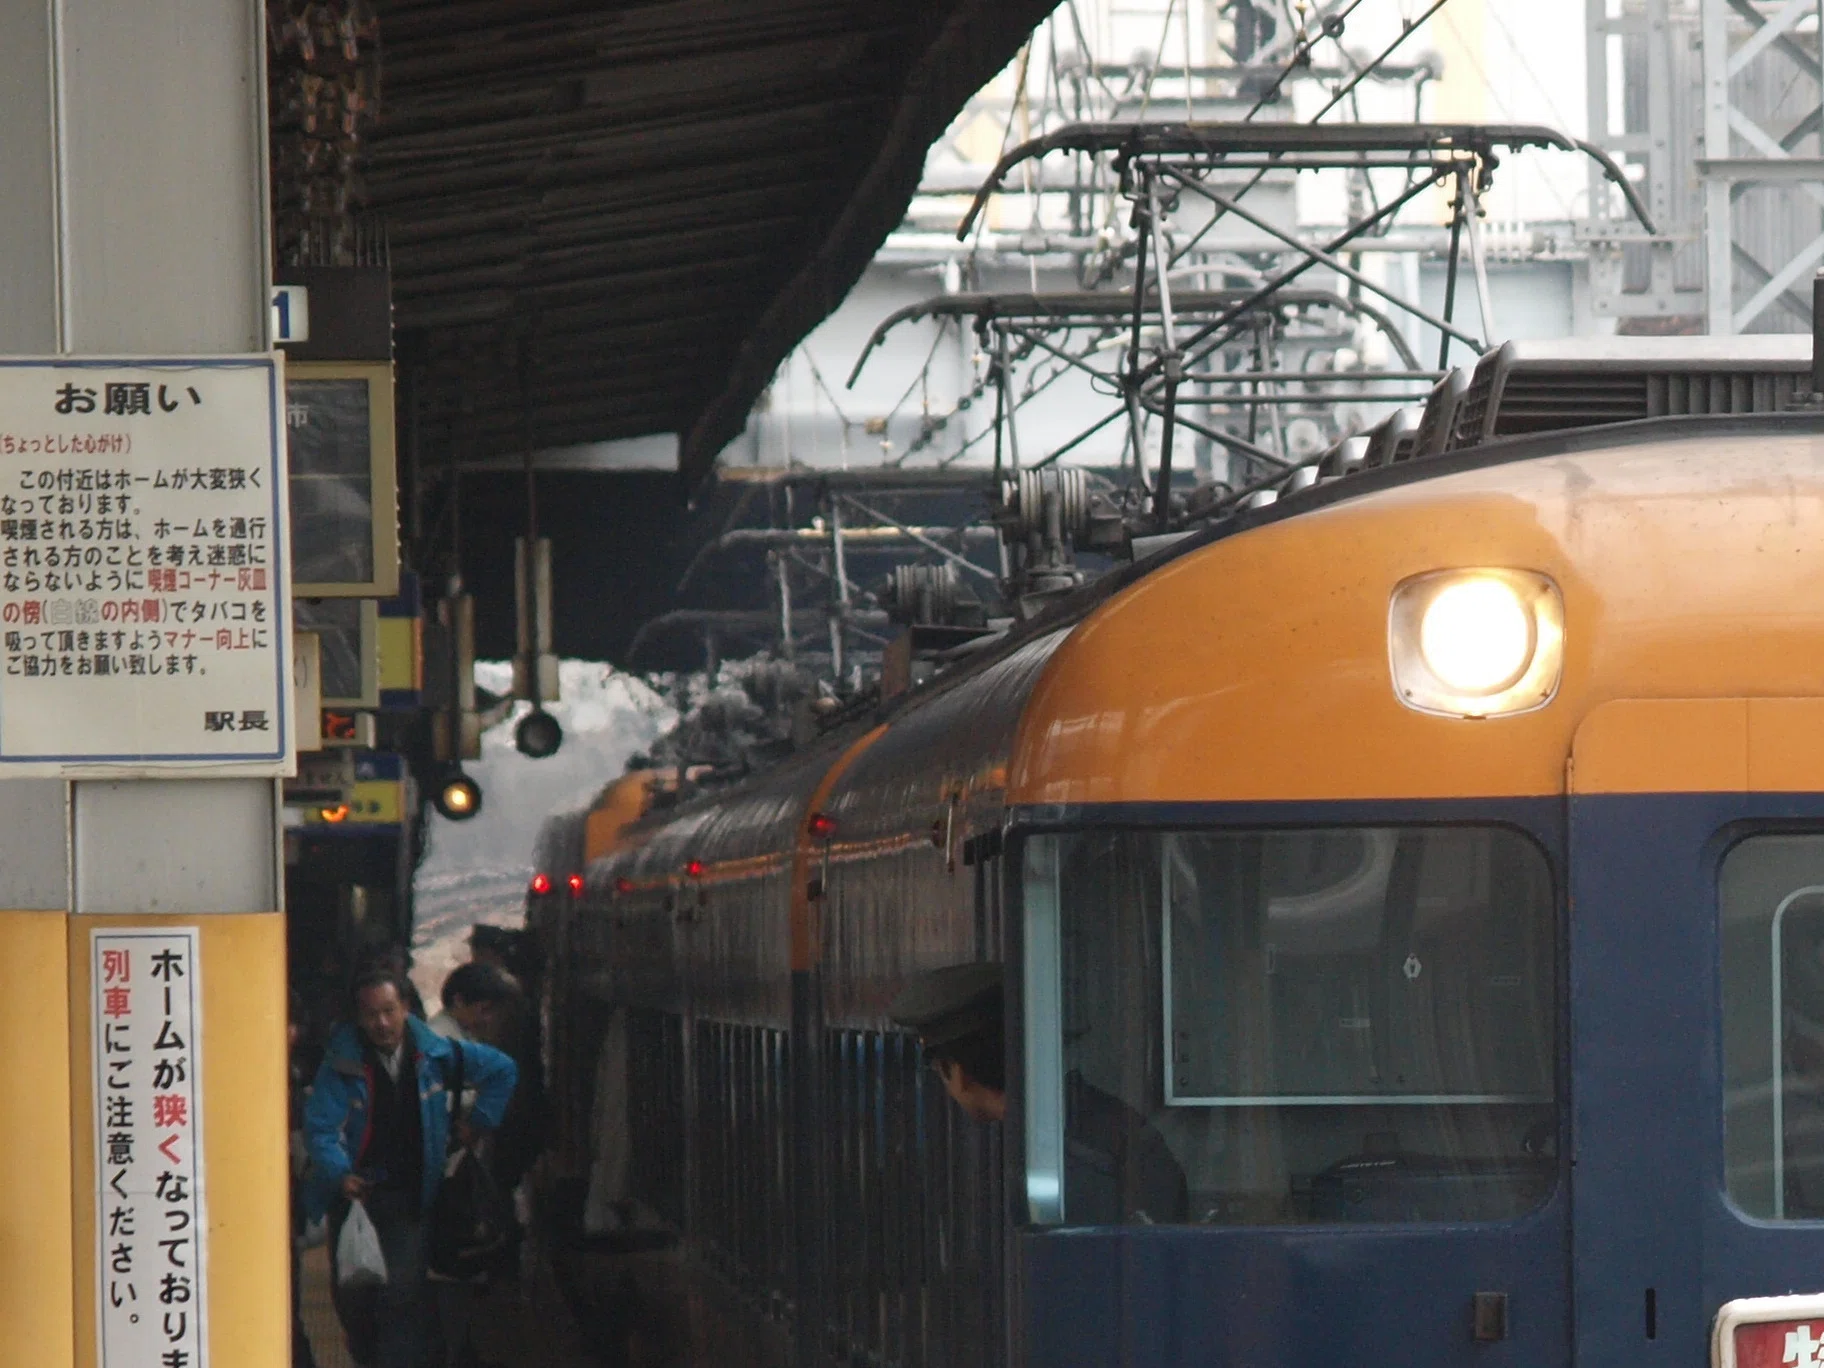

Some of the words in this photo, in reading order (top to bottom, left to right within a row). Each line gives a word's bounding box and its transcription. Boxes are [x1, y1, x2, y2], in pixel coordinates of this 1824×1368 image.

[54, 382, 202, 415] お願い
[20, 467, 263, 491] この付近はホームが大変狭く
[0, 494, 142, 516] なっております。
[3, 544, 267, 567] される方のことを考え迷惑に
[6, 654, 207, 677] ご協力をお願い致します。
[204, 709, 270, 732] 駅長
[102, 949, 140, 1326] 列車にご注意ください。
